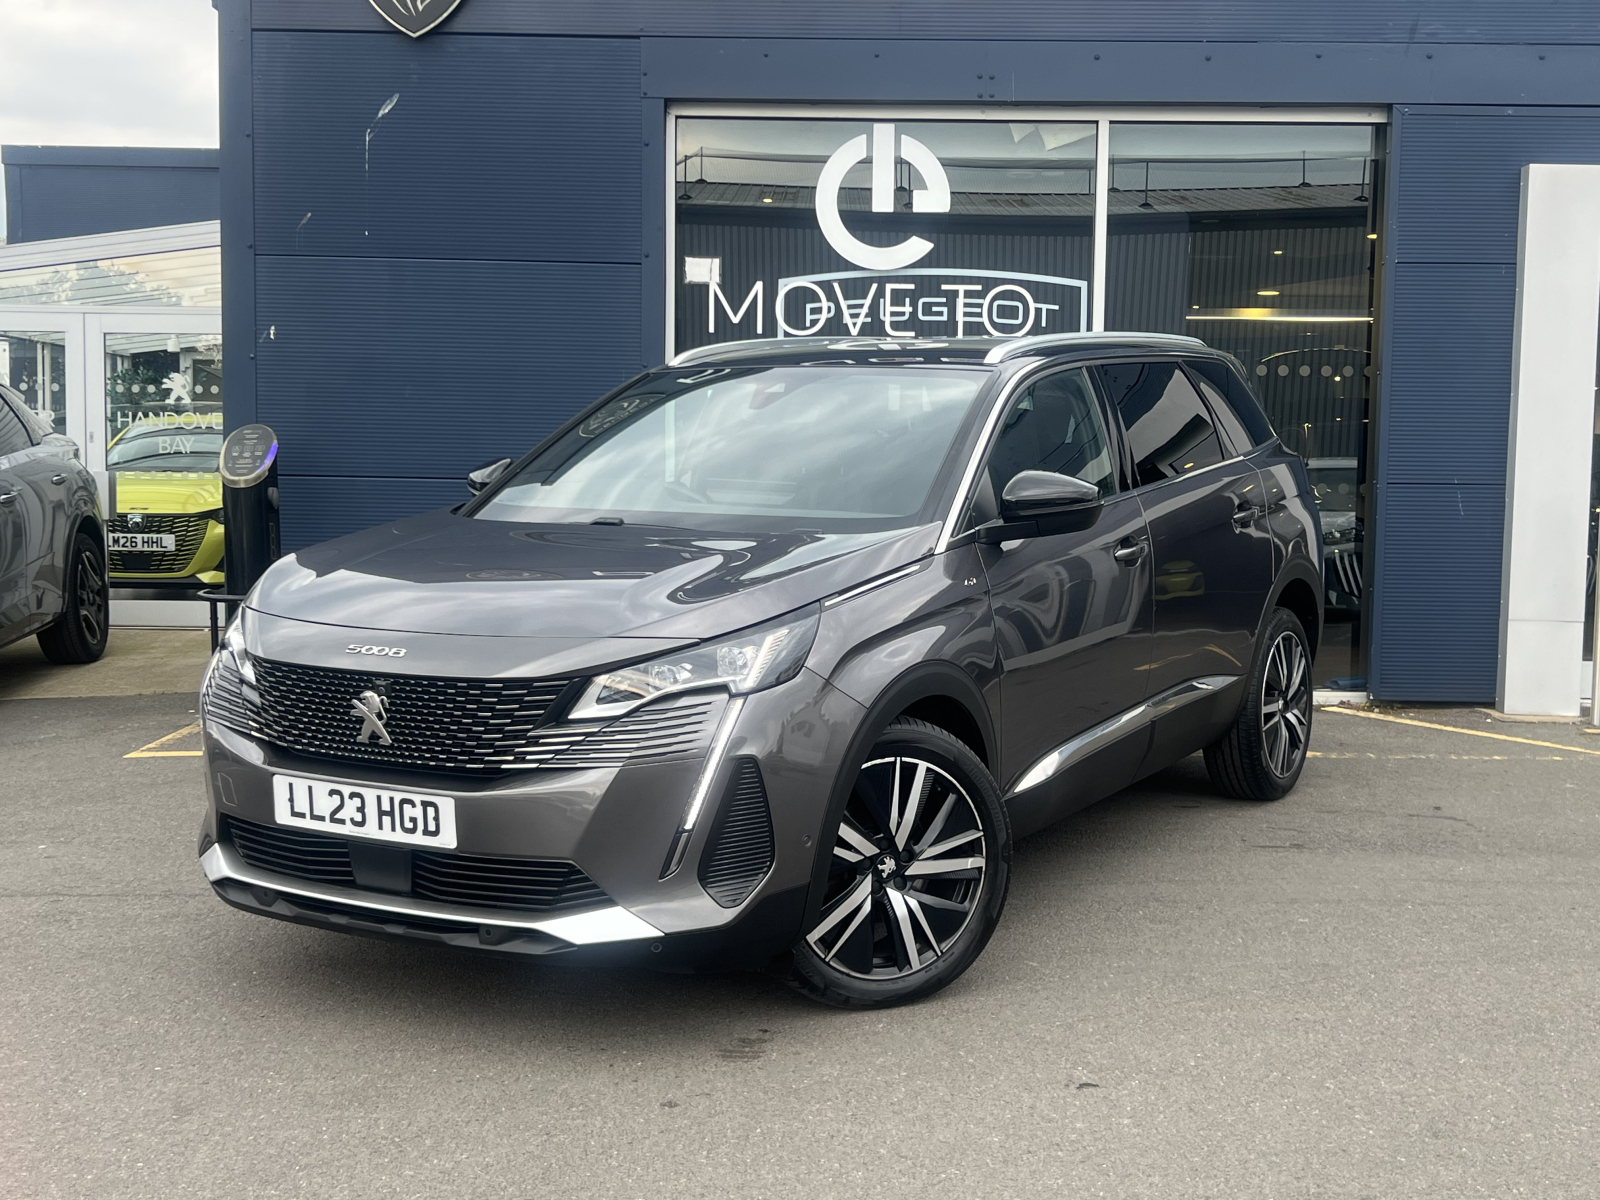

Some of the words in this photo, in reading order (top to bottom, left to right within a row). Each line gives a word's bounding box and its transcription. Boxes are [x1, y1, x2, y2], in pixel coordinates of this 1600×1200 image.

[707, 280, 916, 337] MOVE
[940, 284, 1036, 338] TO
[805, 297, 1060, 327] PEUGEOT
[117, 411, 223, 430] HANDOVE
[158, 436, 195, 454] BAY
[108, 535, 138, 548] M26
[141, 536, 168, 549] HHL
[345, 644, 407, 658] 5008
[288, 782, 367, 828] LL23
[376, 794, 441, 838] HGD
